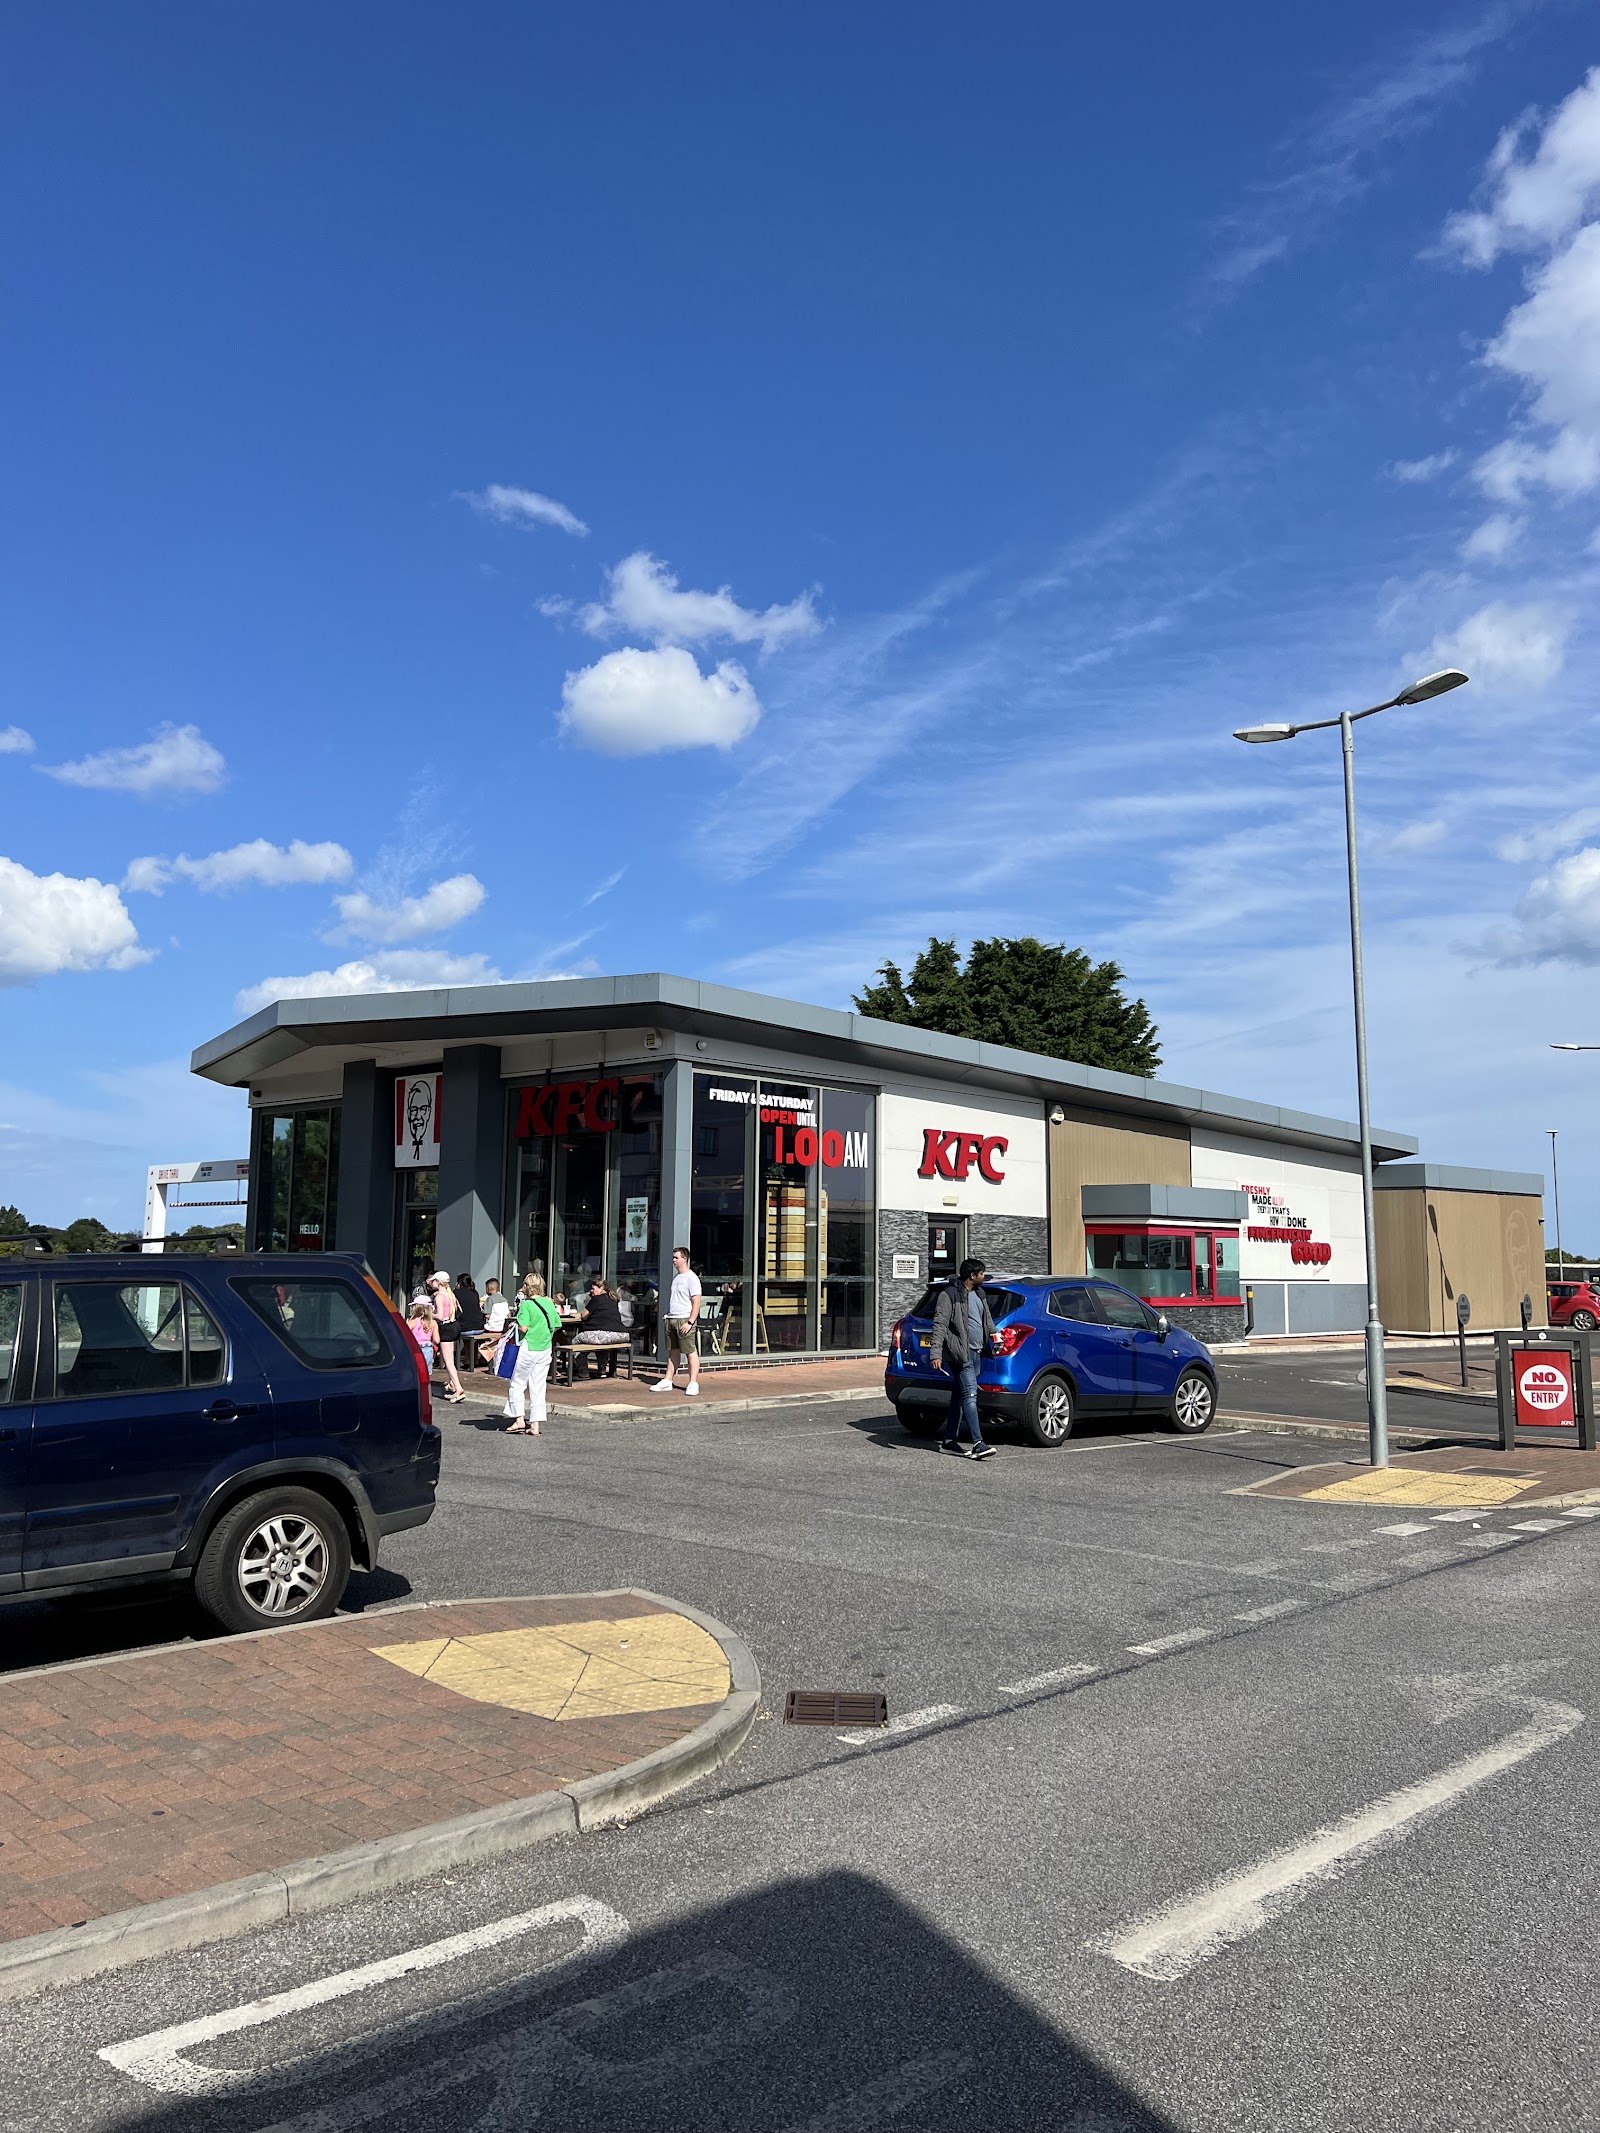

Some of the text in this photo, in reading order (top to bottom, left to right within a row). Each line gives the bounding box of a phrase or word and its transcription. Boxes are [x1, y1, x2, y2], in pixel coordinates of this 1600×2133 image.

[709, 1088, 814, 1110] FRIDAY & SATURDAY
[514, 1078, 619, 1138] KFC
[760, 1108, 817, 1127] OPEN UNTIL
[918, 1129, 1009, 1182] KFC
[1241, 1185, 1270, 1195] FRESHLY
[1252, 1195, 1272, 1205] MADE
[1272, 1207, 1290, 1215] THAT'S
[1287, 1217, 1307, 1227] DONE
[300, 1224, 320, 1235] HELLO
[1291, 1242, 1331, 1263] GOOD
[1531, 1372, 1557, 1384] NO
[1531, 1392, 1560, 1404] ENTRY
